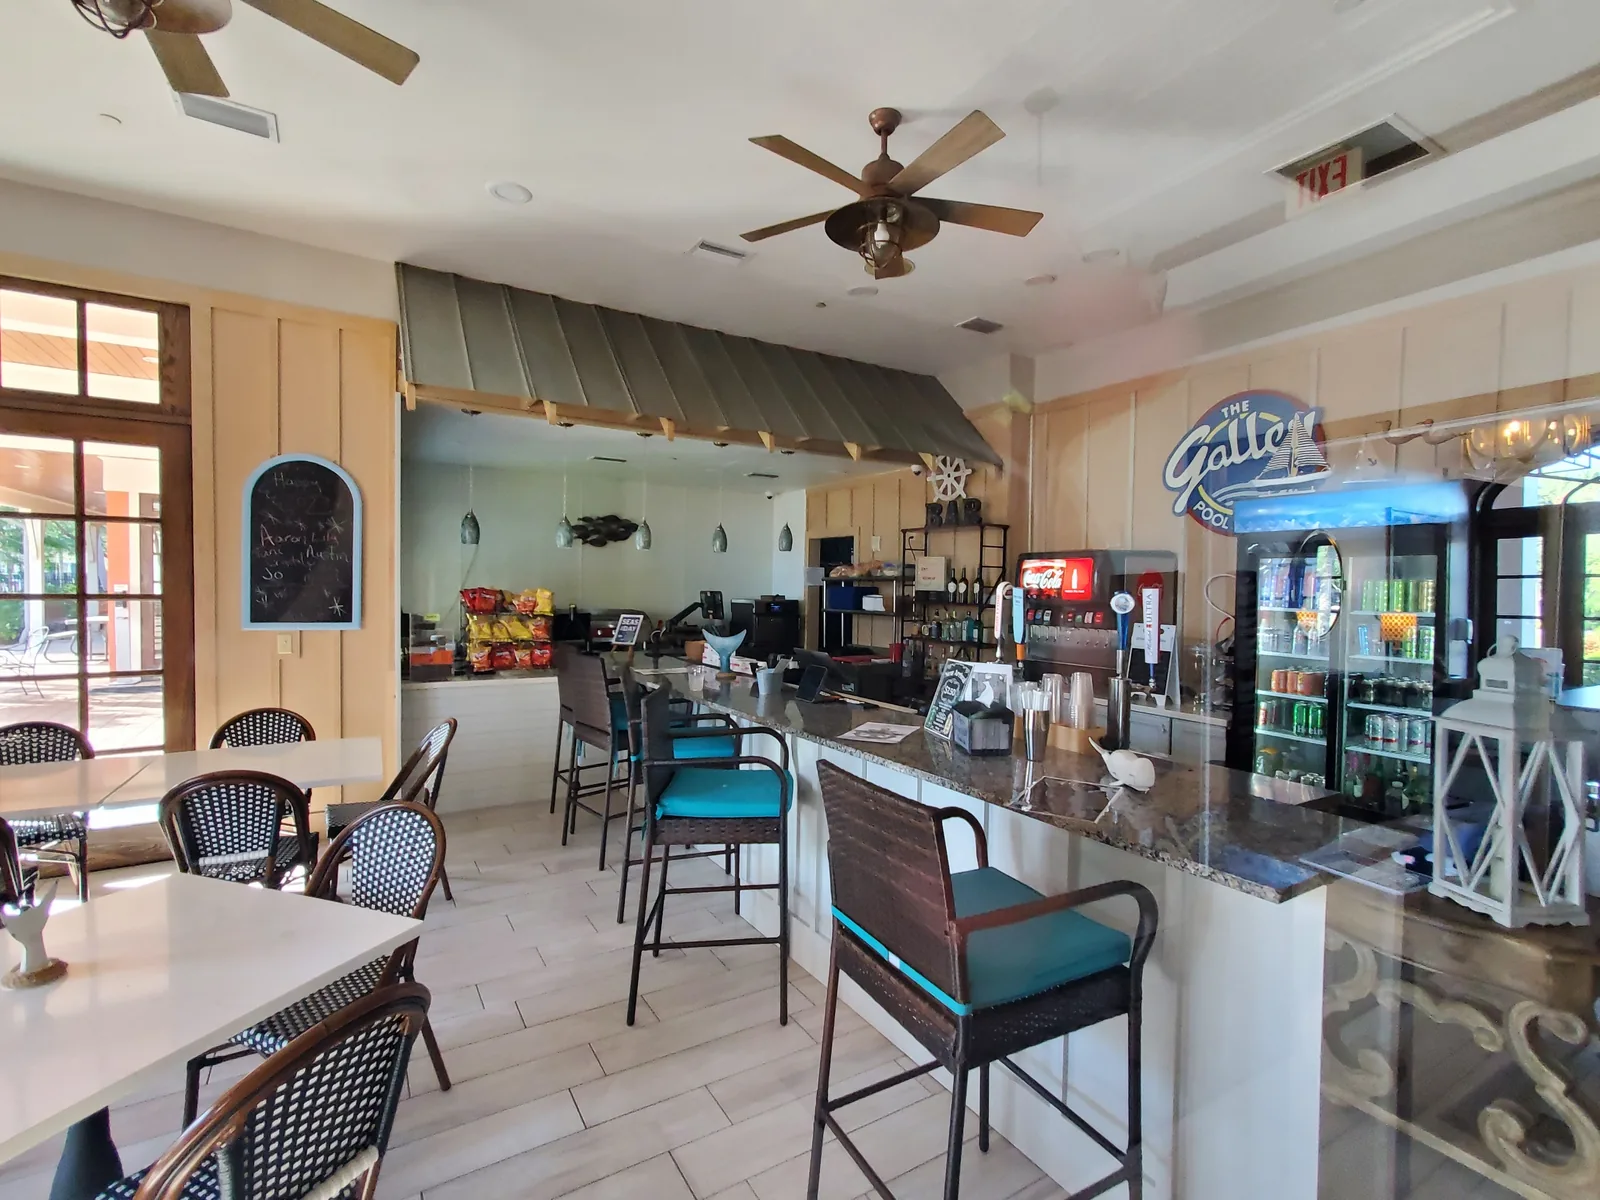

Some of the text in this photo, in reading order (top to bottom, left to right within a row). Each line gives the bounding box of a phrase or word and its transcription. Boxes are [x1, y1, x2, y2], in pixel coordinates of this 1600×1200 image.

[1221, 400, 1250, 419] THE
[926, 498, 983, 527] BAR
[1193, 501, 1229, 530] POOL
